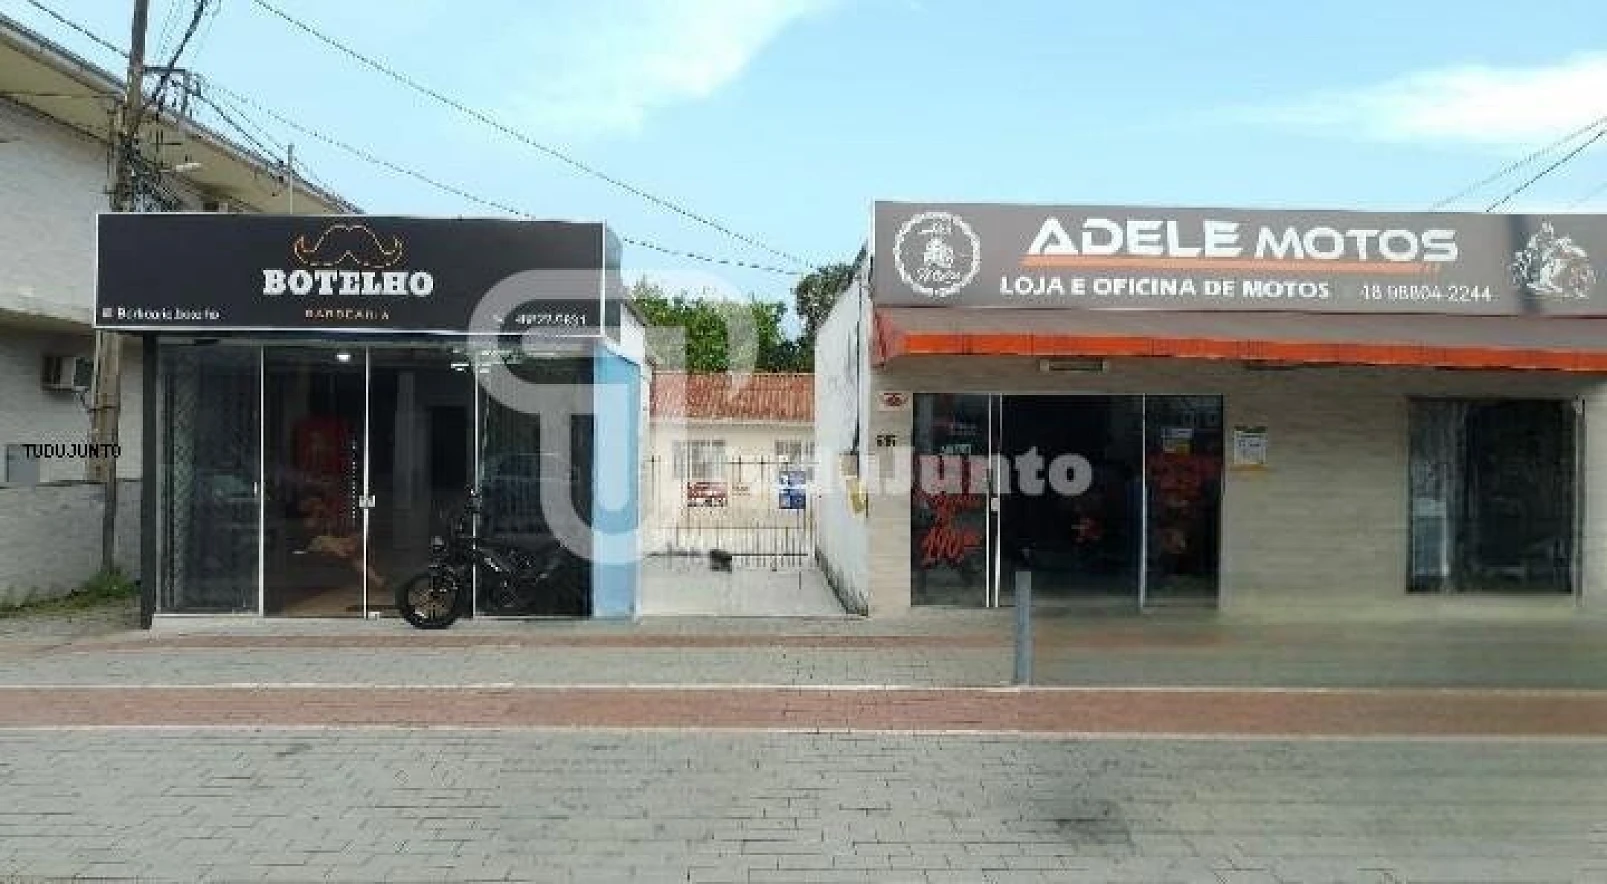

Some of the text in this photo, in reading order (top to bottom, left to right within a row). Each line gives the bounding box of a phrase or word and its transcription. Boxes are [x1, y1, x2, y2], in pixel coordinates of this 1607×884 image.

[1027, 216, 1459, 262] ADELE MOTOS
[262, 268, 435, 297] BOTELHO
[1000, 276, 1330, 299] LOJA E OFICINA DE MOTOS
